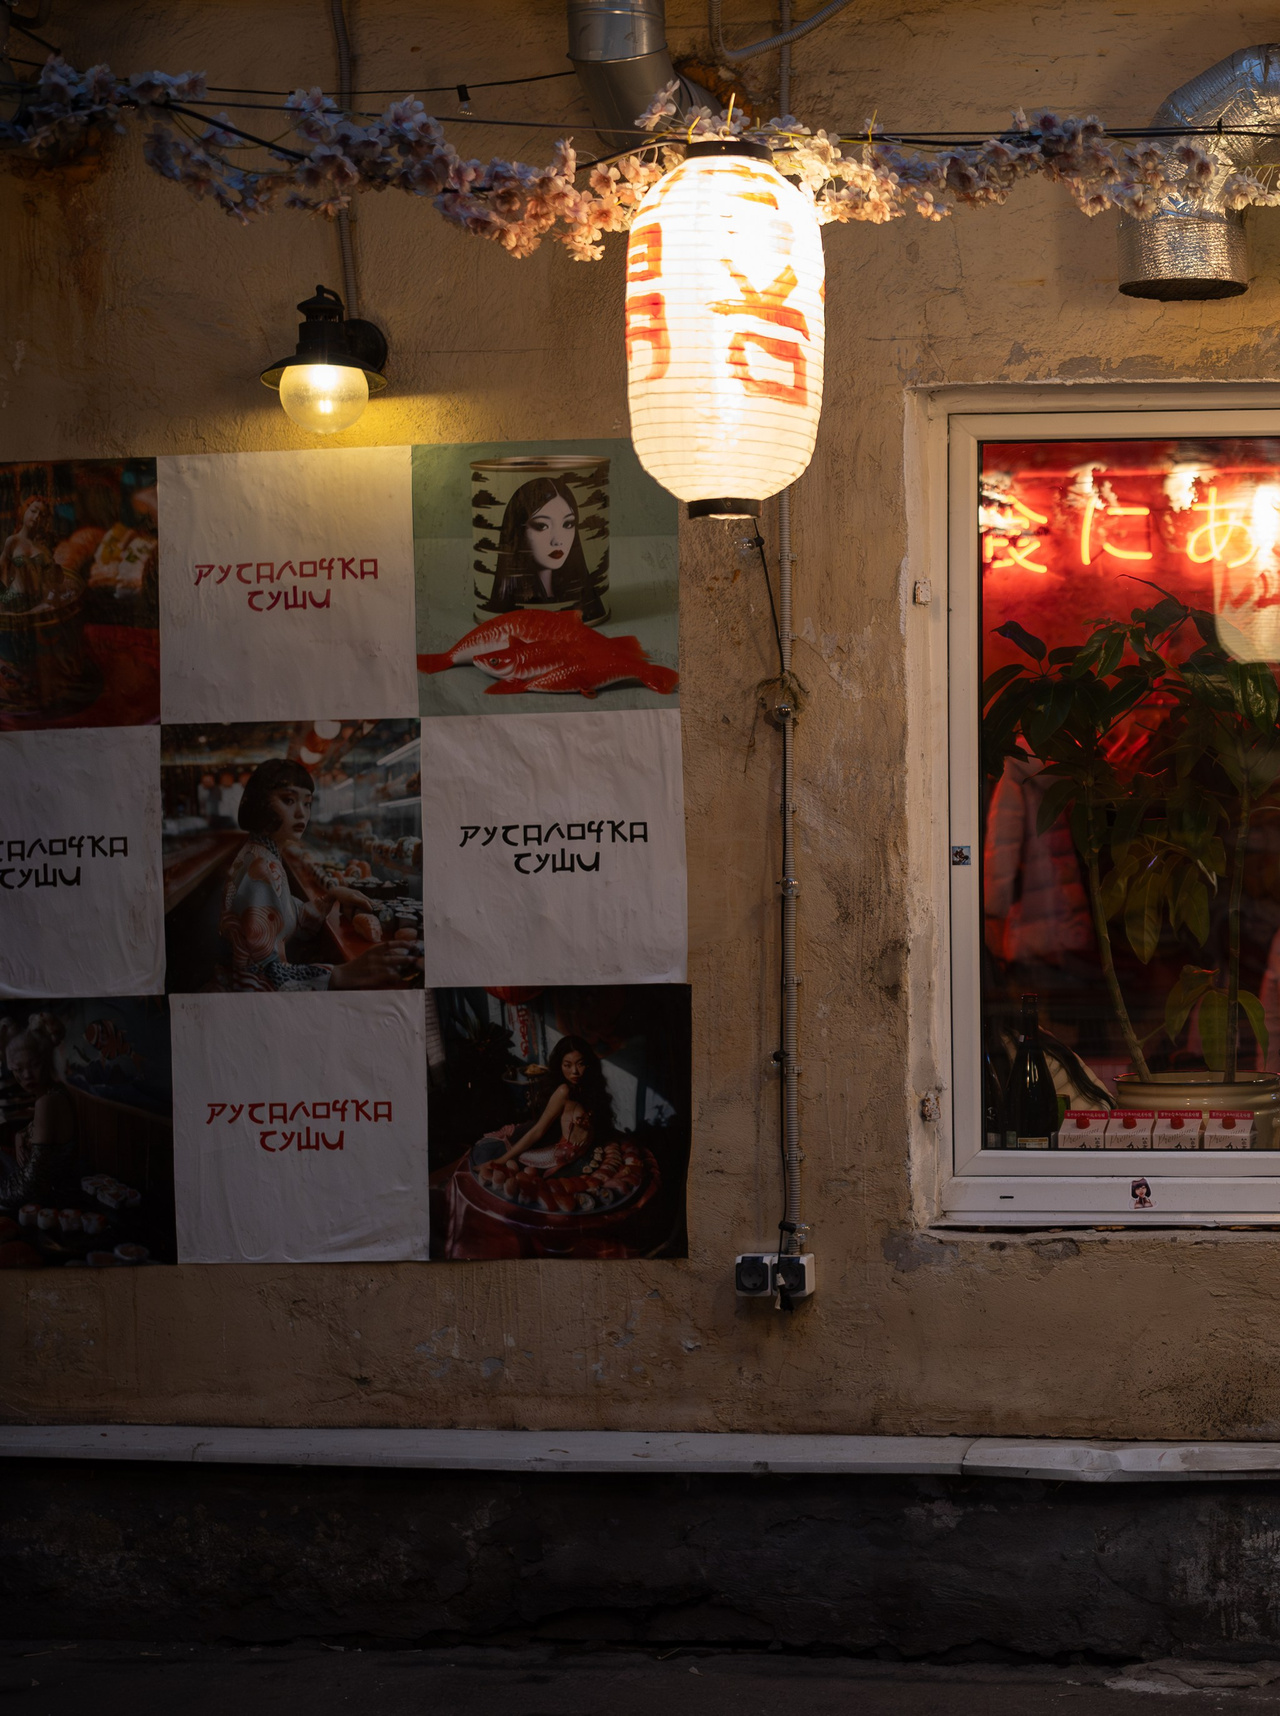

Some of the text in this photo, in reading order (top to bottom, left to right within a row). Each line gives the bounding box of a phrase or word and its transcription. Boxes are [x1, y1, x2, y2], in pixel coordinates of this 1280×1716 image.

[193, 557, 379, 586] РУСАЛОЧКА
[247, 585, 331, 612] СУШИ
[459, 819, 649, 848] РУСАЛОЧКА
[0, 835, 128, 862] АЛОЧКА
[514, 848, 600, 875] СУШИ
[0, 863, 81, 889] СУШИ
[206, 1099, 392, 1125] РУСАЛОЧКА
[259, 1126, 345, 1152] СУШИ
